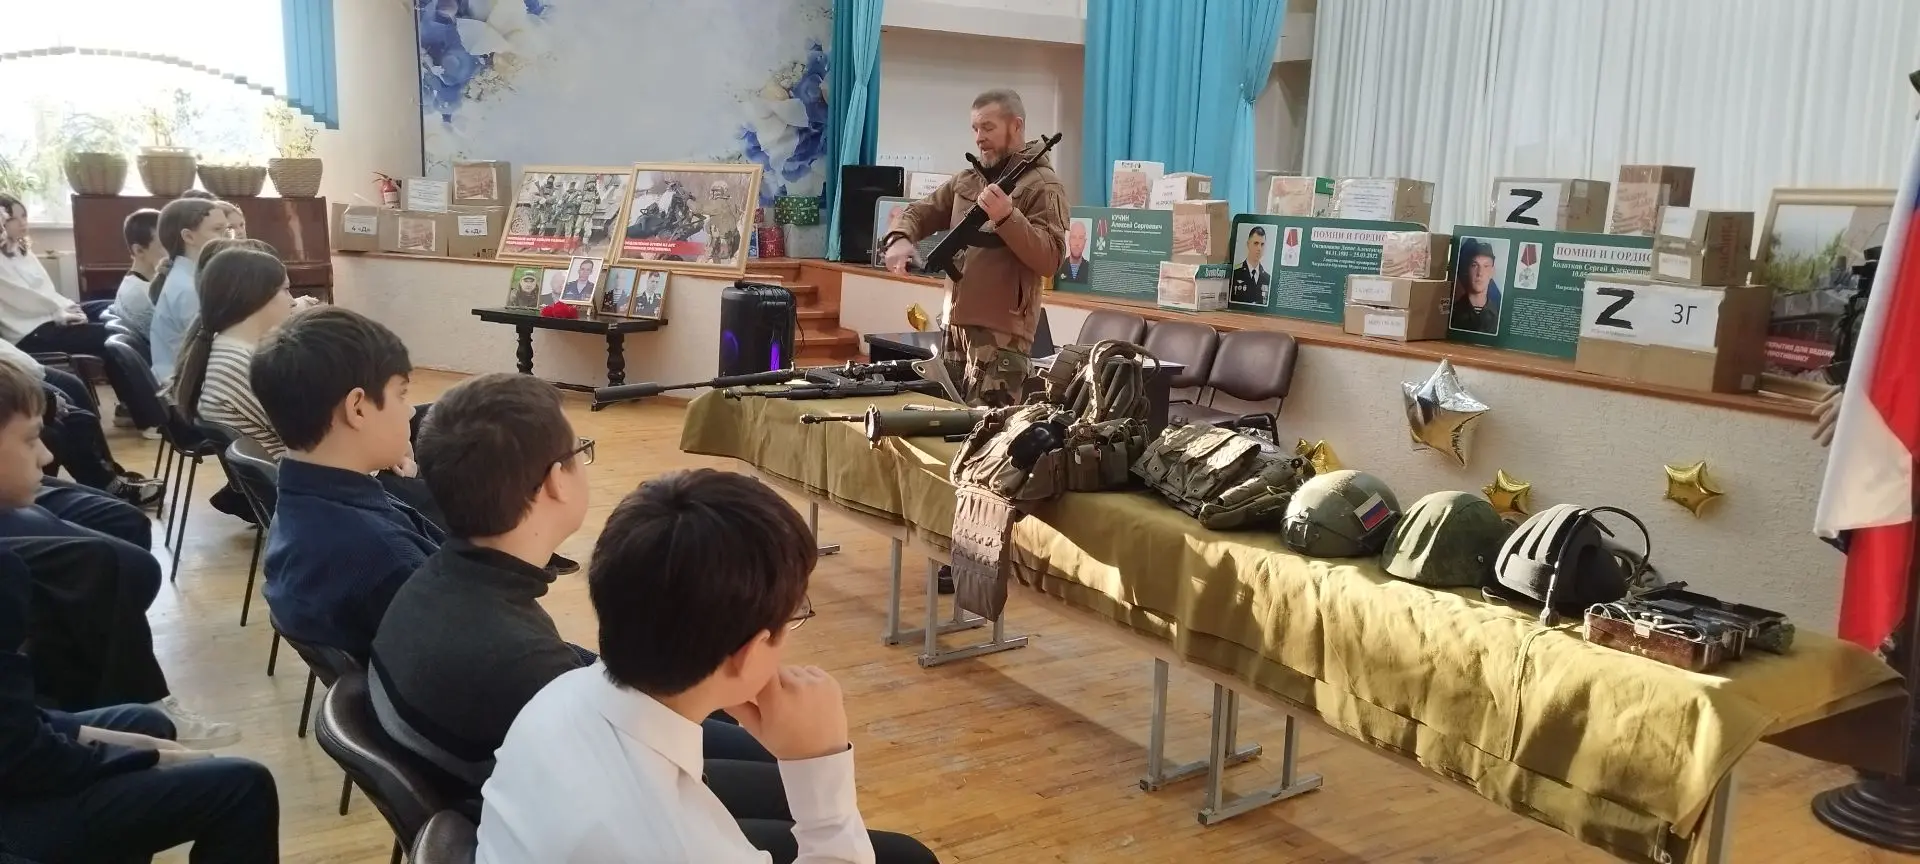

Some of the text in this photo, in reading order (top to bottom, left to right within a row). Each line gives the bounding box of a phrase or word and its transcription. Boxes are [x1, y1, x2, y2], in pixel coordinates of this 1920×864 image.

[1506, 188, 1543, 226] Z
[1313, 230, 1344, 239] ПОМНИ
[1346, 232, 1353, 240] И
[1556, 246, 1596, 257] ПОМНИ
[1600, 249, 1608, 258] И
[1595, 287, 1635, 330] Z
